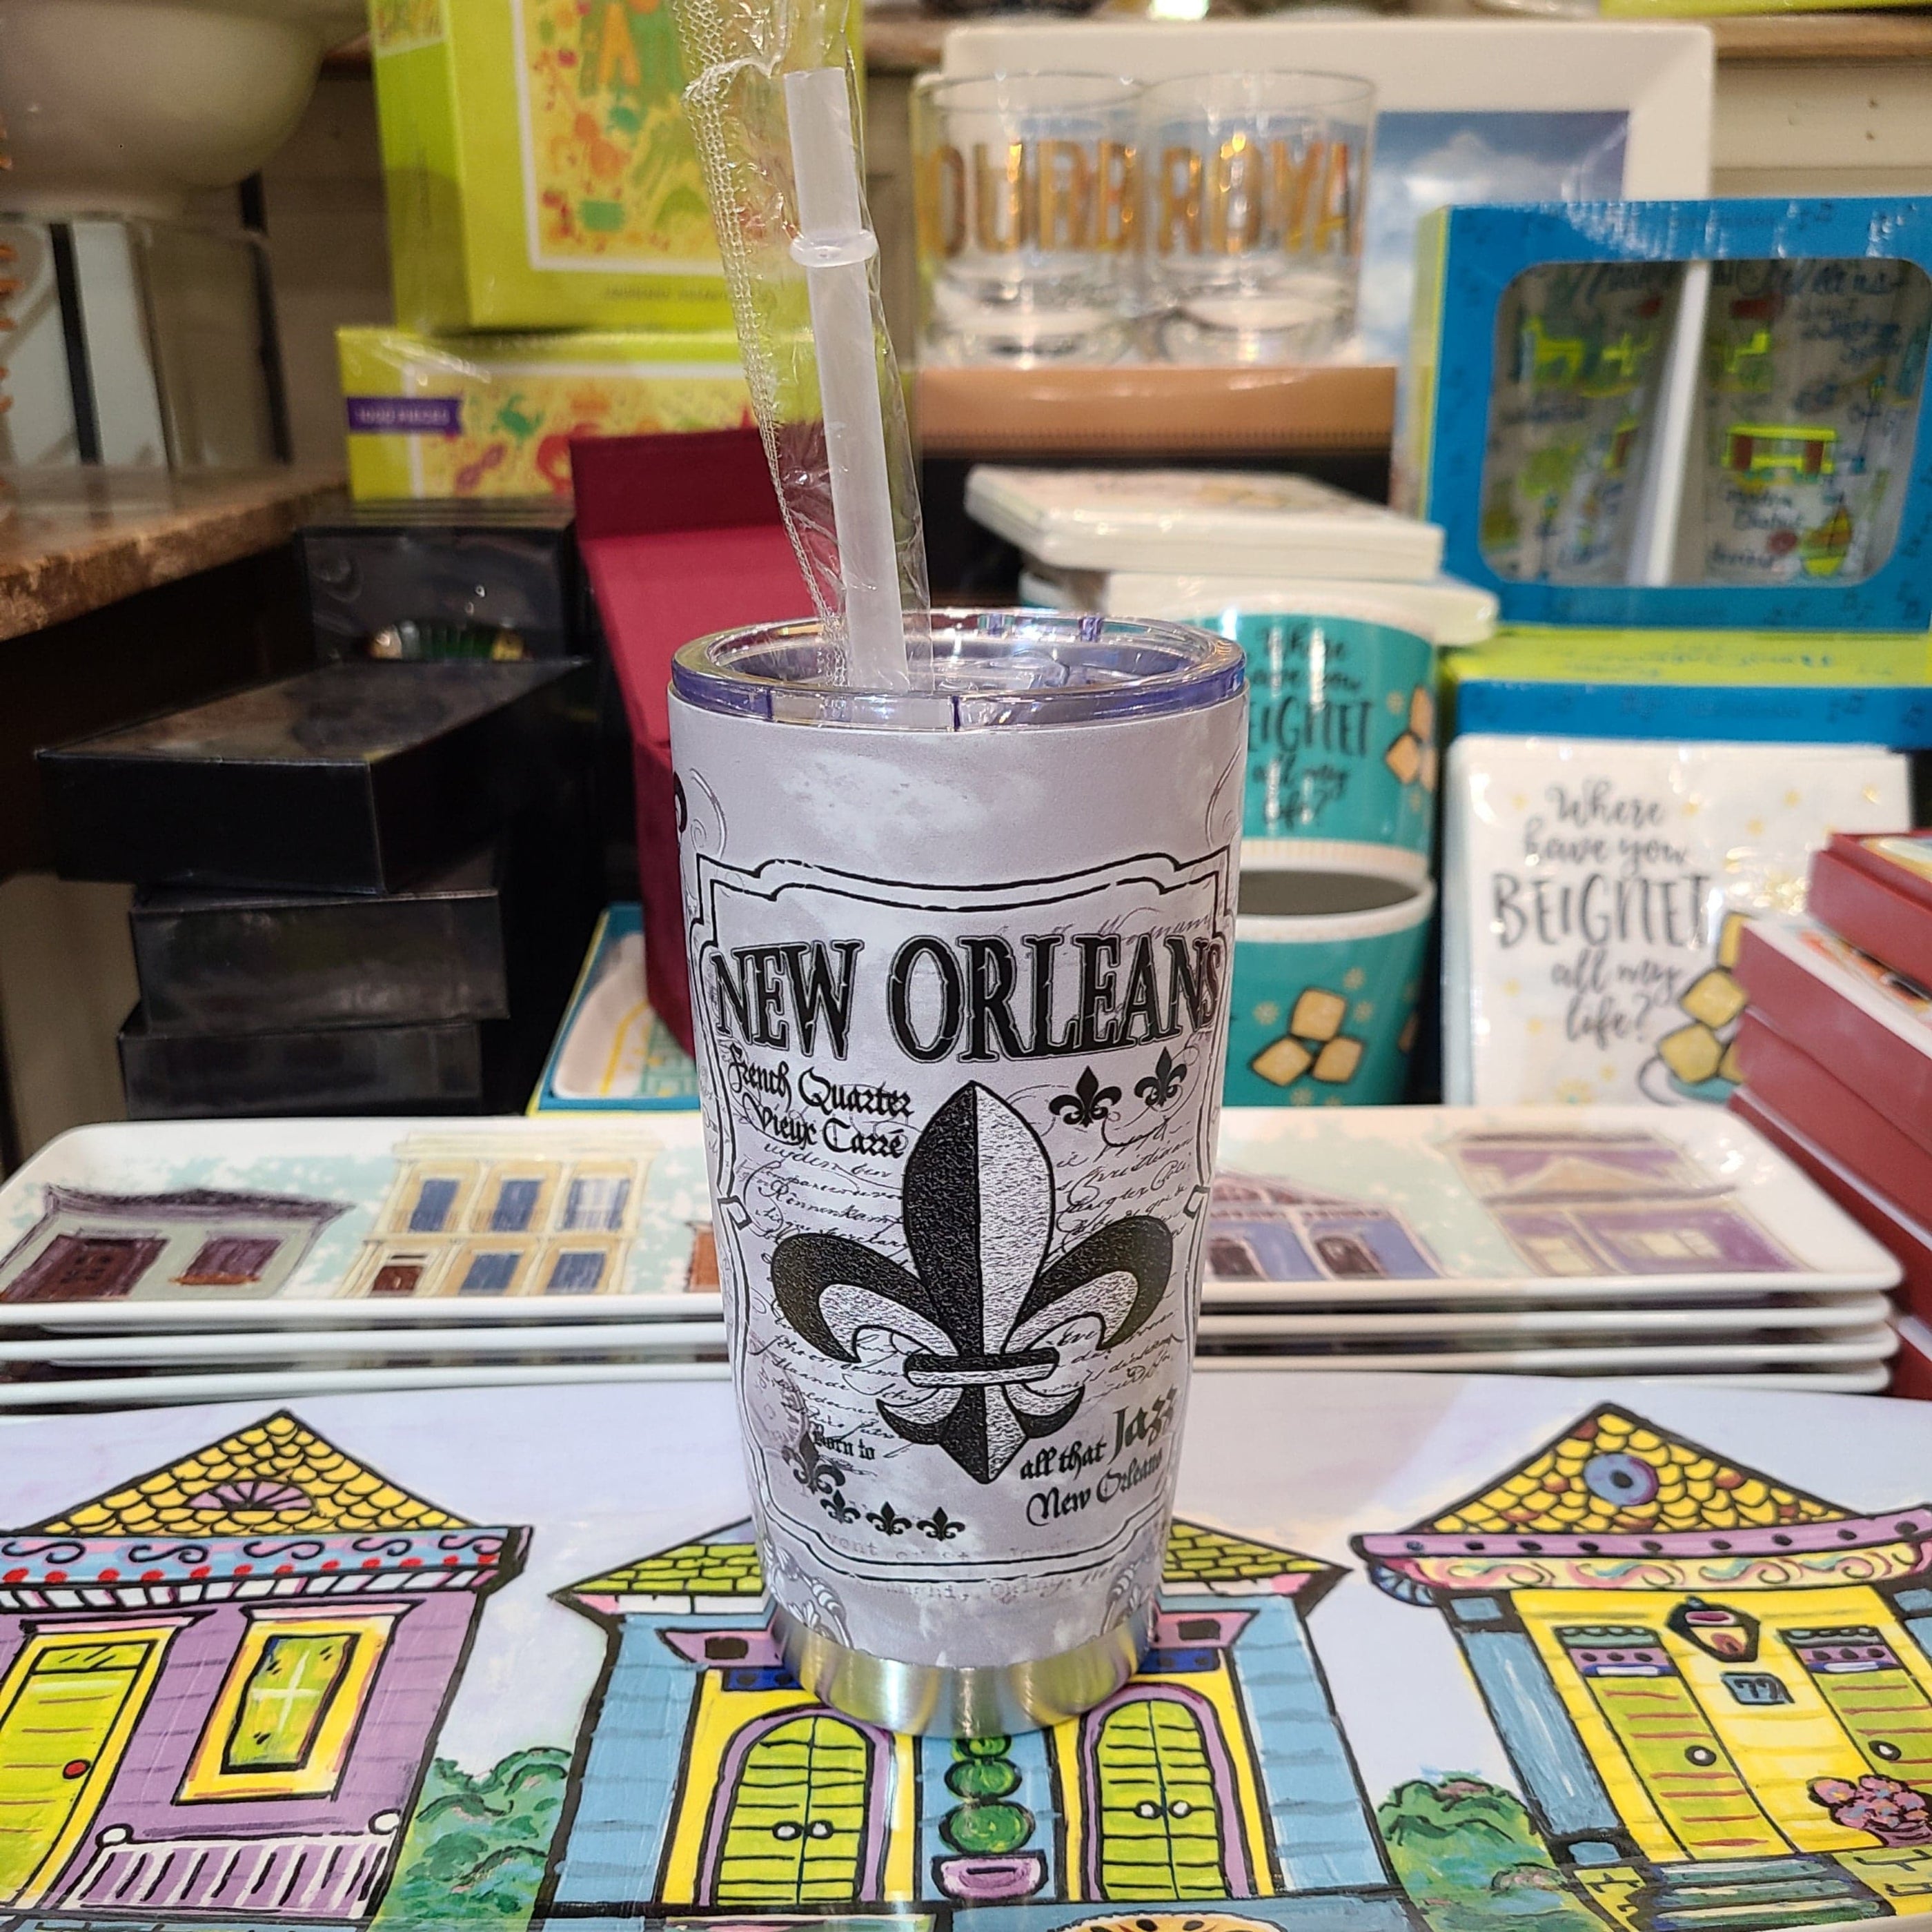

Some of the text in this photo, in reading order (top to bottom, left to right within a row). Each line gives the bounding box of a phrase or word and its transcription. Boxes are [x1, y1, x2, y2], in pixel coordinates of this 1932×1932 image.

[1546, 778, 1664, 826] Where
[1523, 817, 1686, 876] have you
[1493, 872, 1710, 950] BEIGNET
[709, 934, 1225, 1063] NEW ORLEANS
[1550, 948, 1684, 1005] all my
[727, 1043, 915, 1116] French Quarter
[742, 1092, 818, 1150] Vieux
[858, 1438, 876, 1461] to
[1020, 1383, 1178, 1481] all that Jazz
[1026, 1446, 1163, 1527] New Orleans
